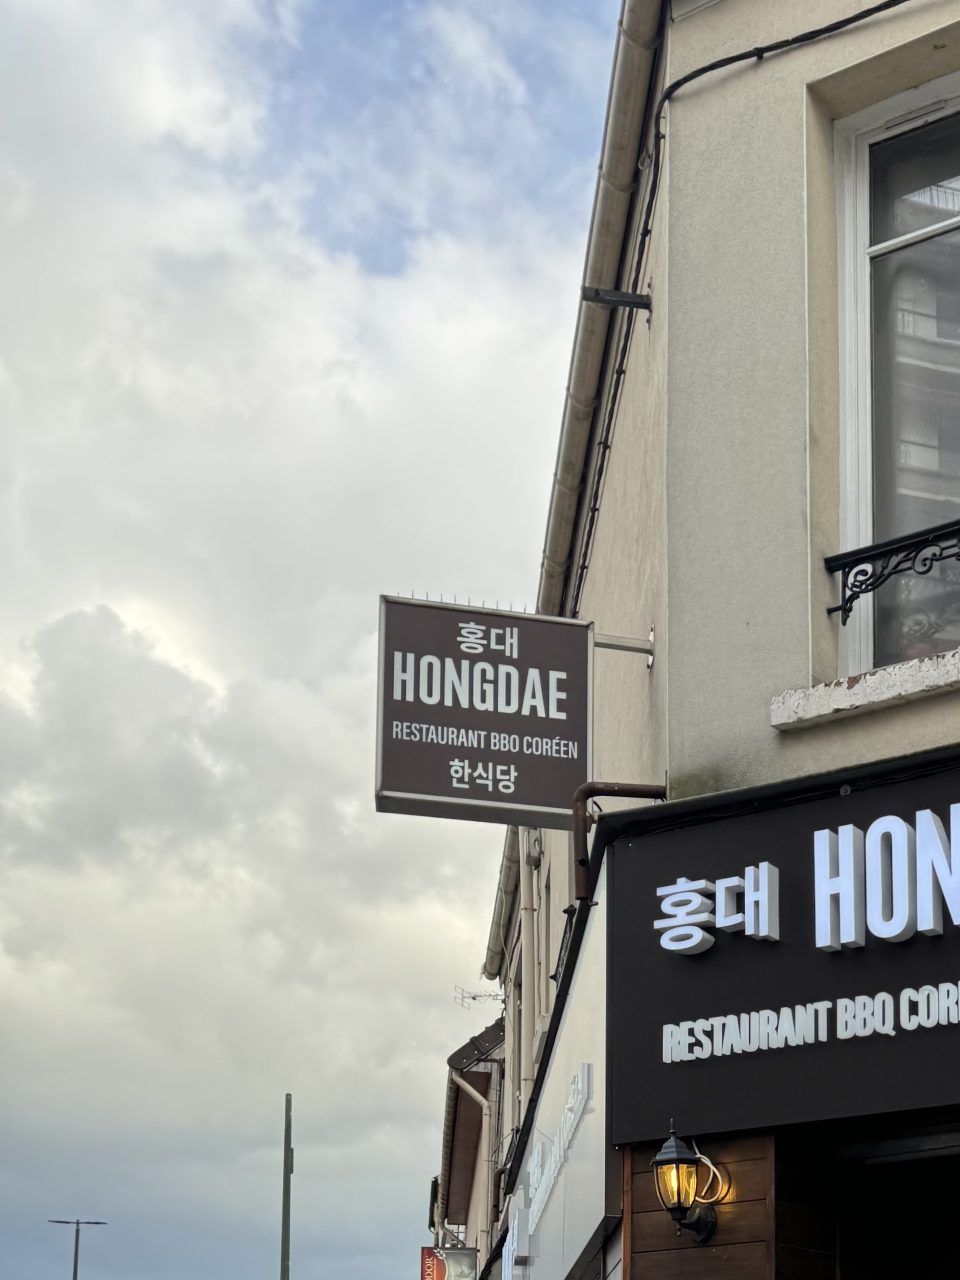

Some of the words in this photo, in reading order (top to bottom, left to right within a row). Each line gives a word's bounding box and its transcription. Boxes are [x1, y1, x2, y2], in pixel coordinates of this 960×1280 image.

[457, 622, 518, 659] 홍대
[393, 651, 567, 720] HONGDAE
[393, 721, 487, 749] RESTAURANT
[523, 736, 578, 759] CORÉEN
[449, 758, 518, 793] 한식당
[653, 861, 779, 955] 홍대
[662, 1001, 833, 1063] RESTAURANT
[836, 992, 896, 1039] BBQ
